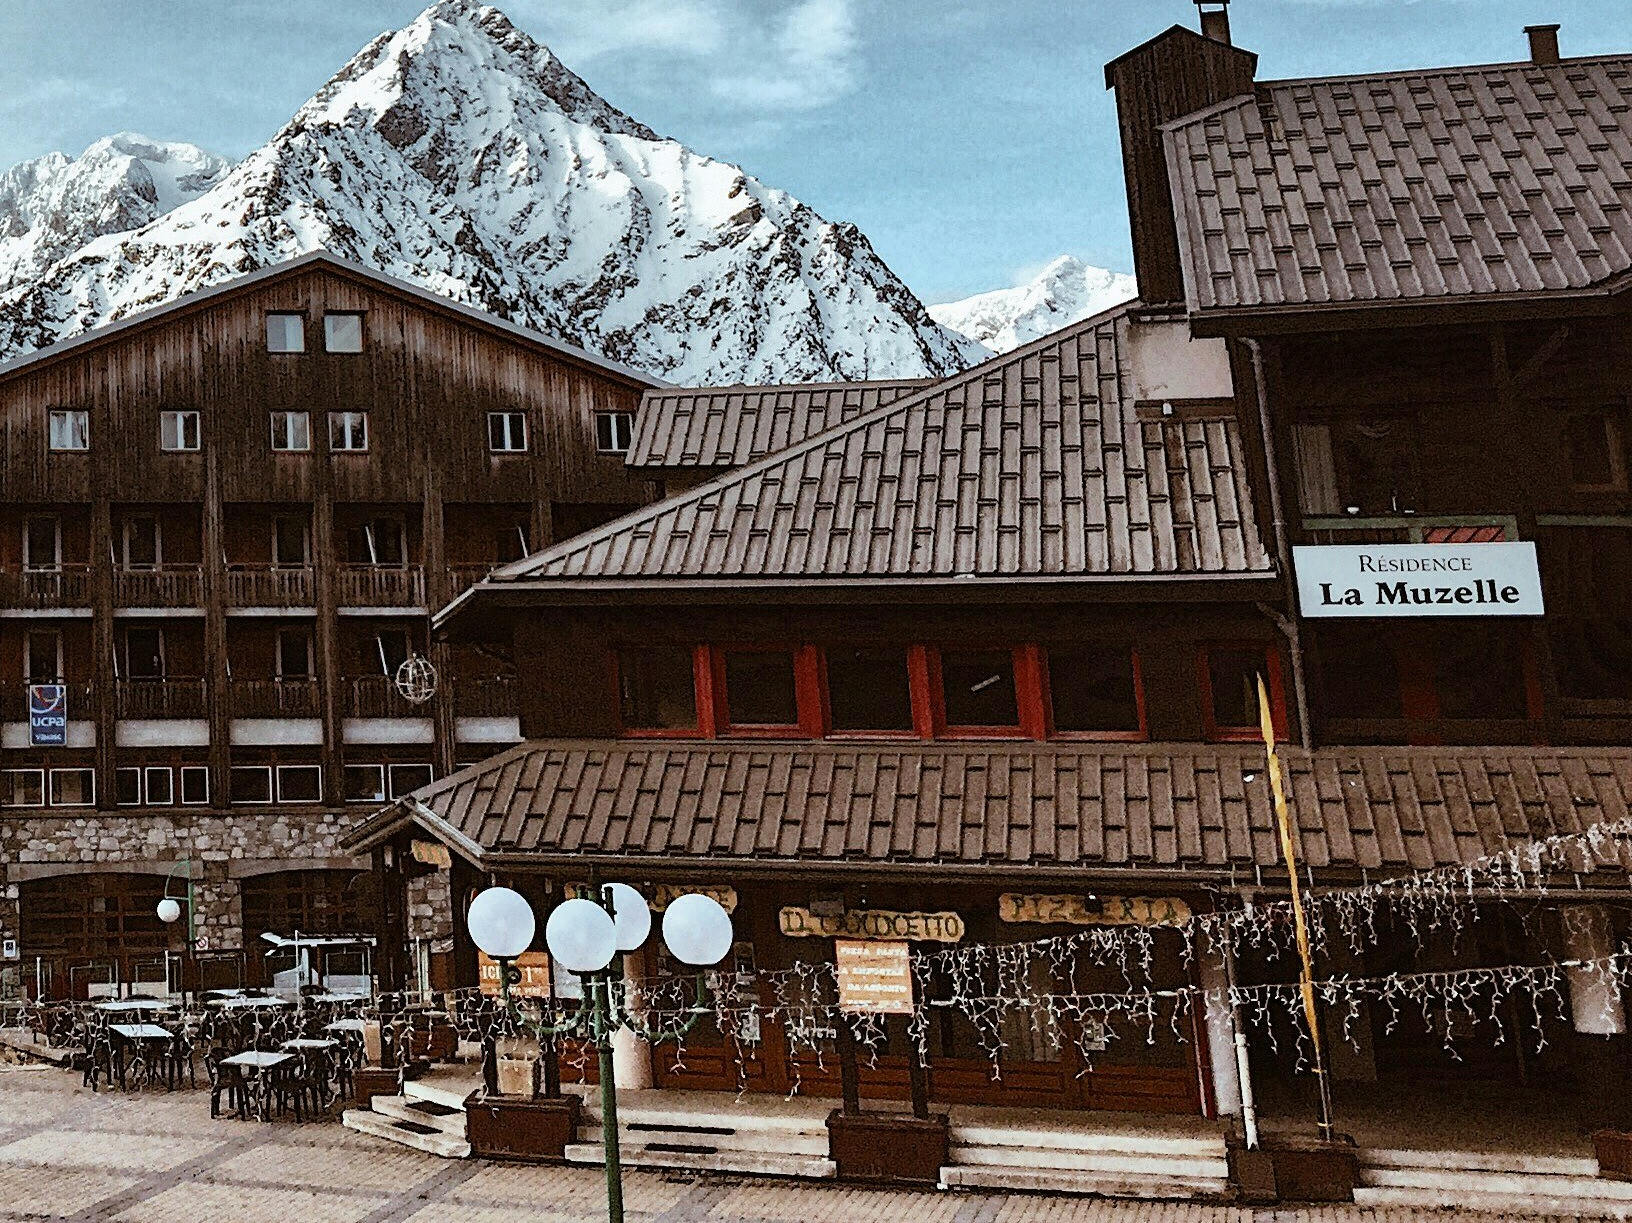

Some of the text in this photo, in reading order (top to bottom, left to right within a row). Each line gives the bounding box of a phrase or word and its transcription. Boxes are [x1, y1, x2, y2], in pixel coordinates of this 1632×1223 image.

[1319, 579, 1520, 606] La Muzelle
[782, 911, 813, 932] IL
